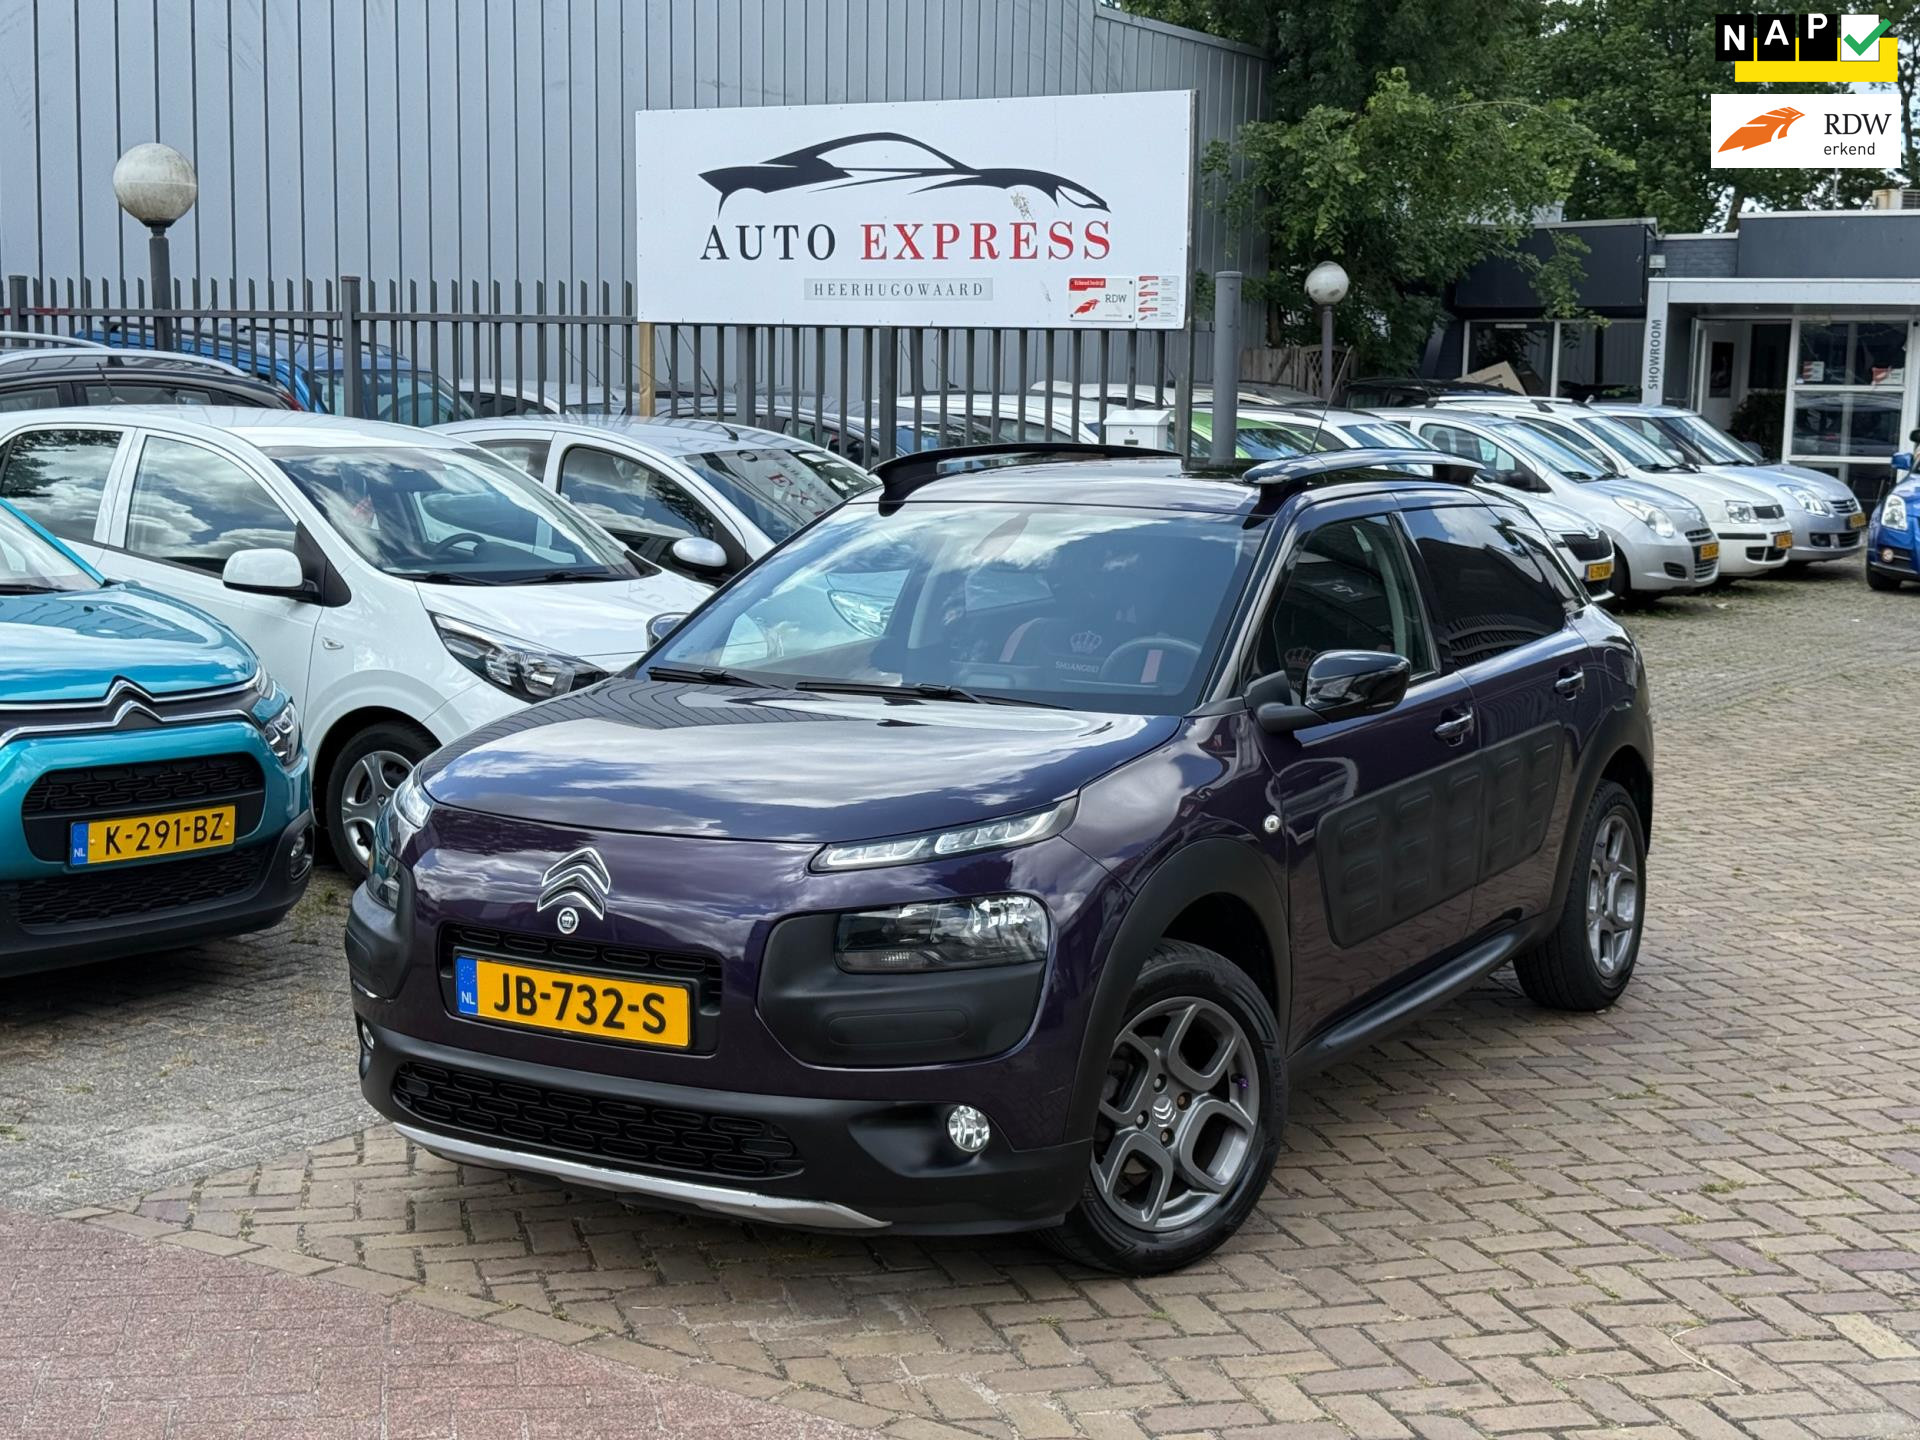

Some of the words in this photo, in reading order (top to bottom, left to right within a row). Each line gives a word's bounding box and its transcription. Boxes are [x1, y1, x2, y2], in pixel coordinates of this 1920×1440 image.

[700, 224, 836, 261] AUTO
[860, 221, 1111, 261] EXPRESS
[813, 282, 984, 297] HEERHUGOWAARD
[1105, 294, 1127, 303] RDW
[1648, 320, 1662, 390] SHOWROOM
[105, 812, 225, 856] K-291-BZ
[73, 847, 86, 858] NL
[461, 990, 476, 1005] NL
[493, 972, 667, 1035] JB-732-S
